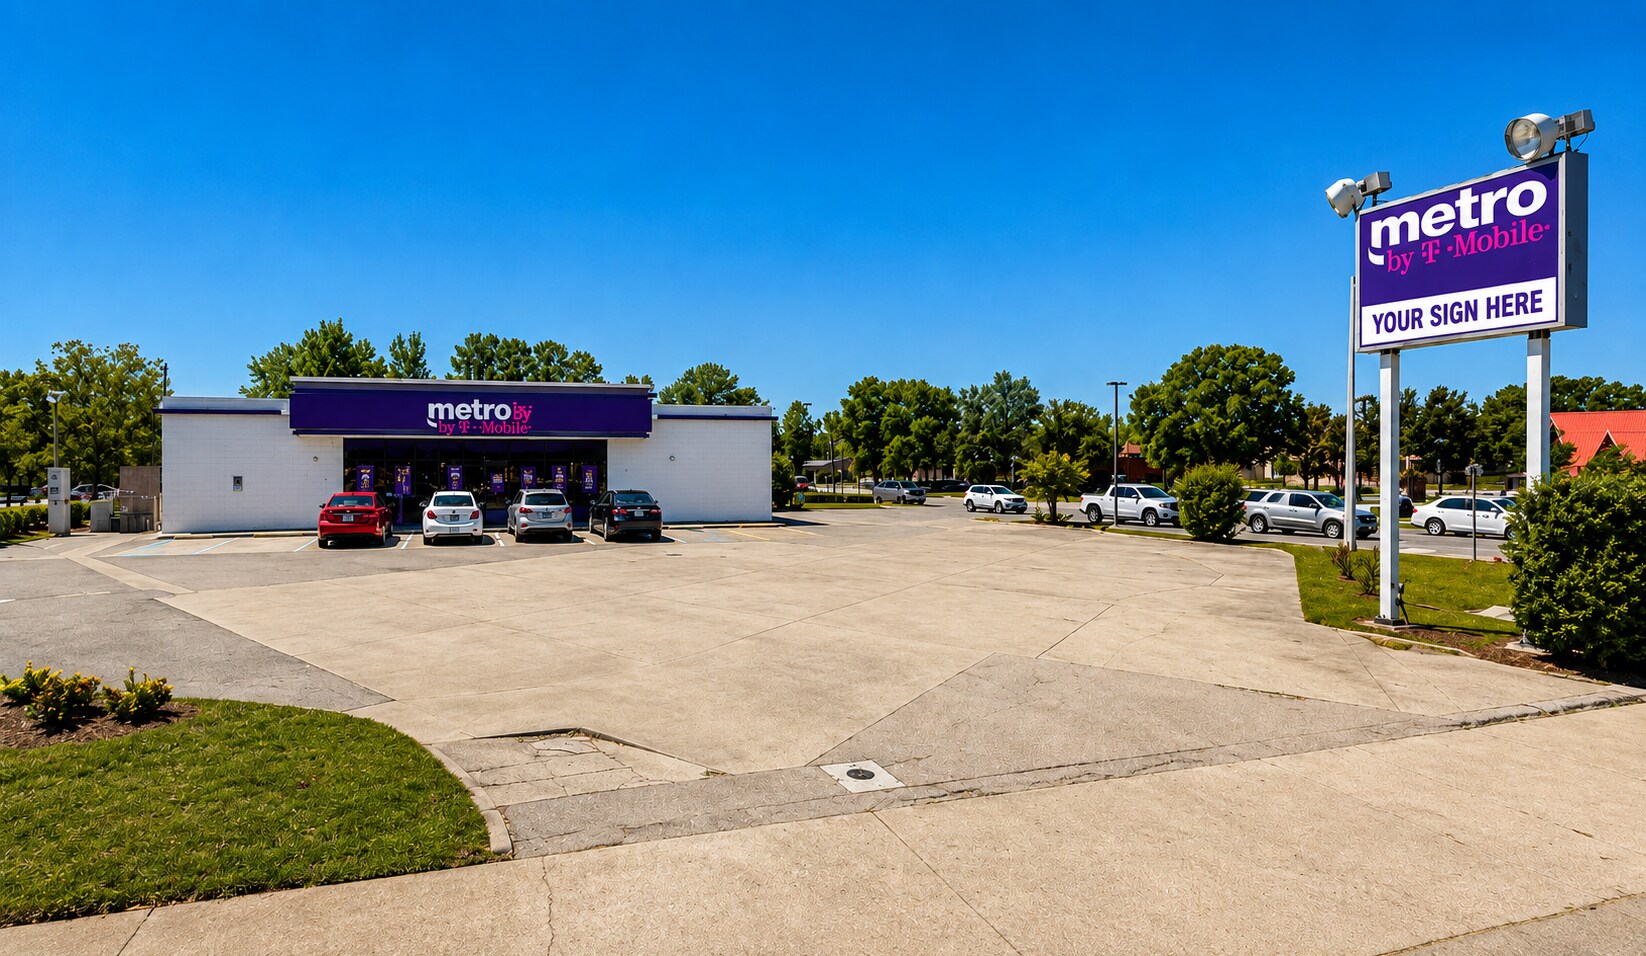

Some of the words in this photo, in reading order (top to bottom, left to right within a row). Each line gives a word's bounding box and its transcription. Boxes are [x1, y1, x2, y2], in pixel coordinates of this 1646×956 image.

[1370, 180, 1548, 249] metro
[1386, 249, 1415, 275] by
[1372, 307, 1424, 335] YOUR
[1429, 299, 1479, 328] SIGN
[1486, 289, 1544, 320] HERE
[427, 399, 512, 421] metro
[438, 420, 456, 436] by
